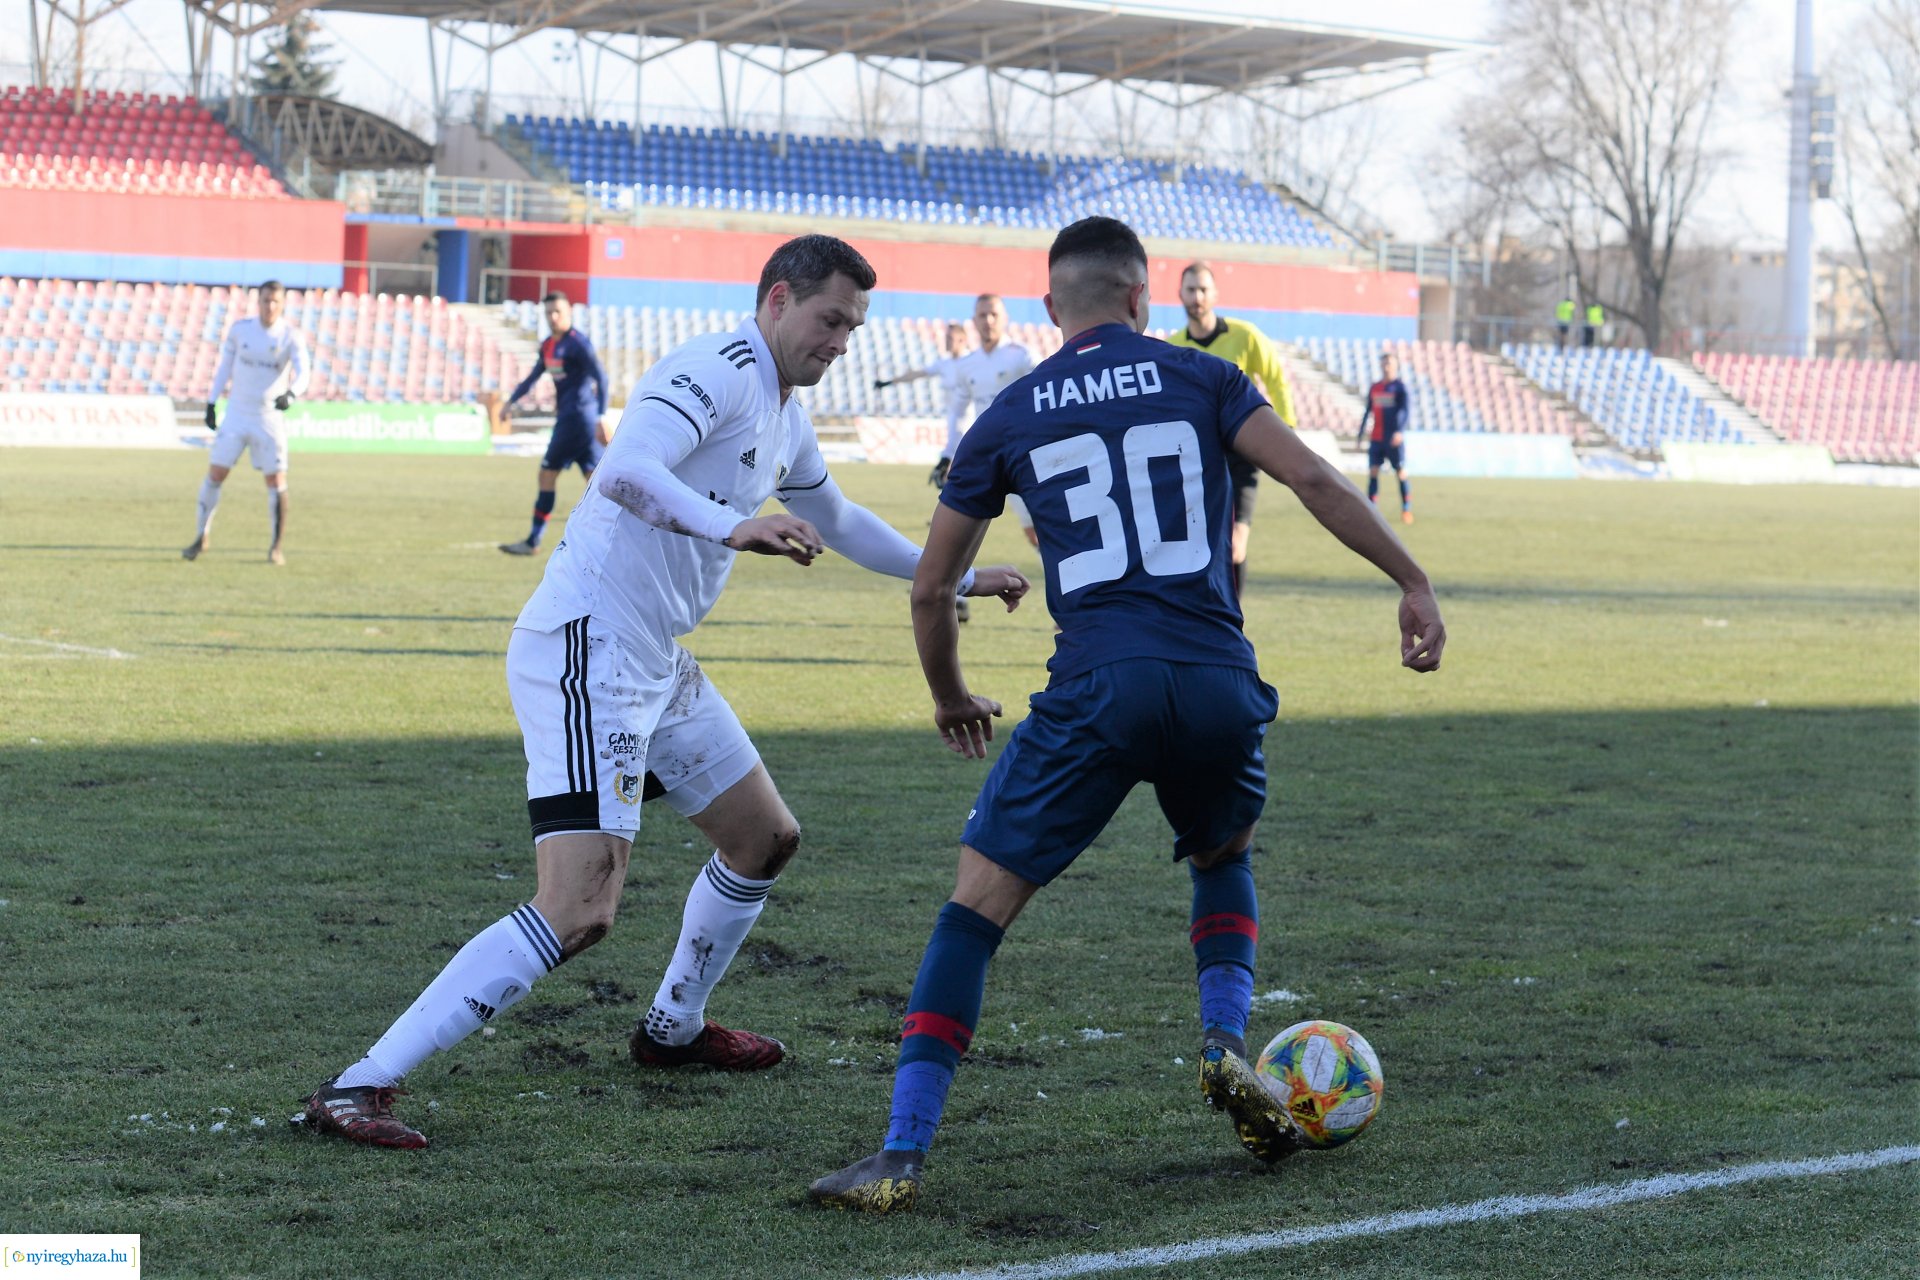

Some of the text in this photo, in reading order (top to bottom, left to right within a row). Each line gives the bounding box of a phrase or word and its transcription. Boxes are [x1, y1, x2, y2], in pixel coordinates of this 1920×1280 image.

[688, 383, 718, 419] SET
[1033, 361, 1162, 413] HAMED
[65, 406, 160, 426] TRANS
[1029, 420, 1212, 596] 30
